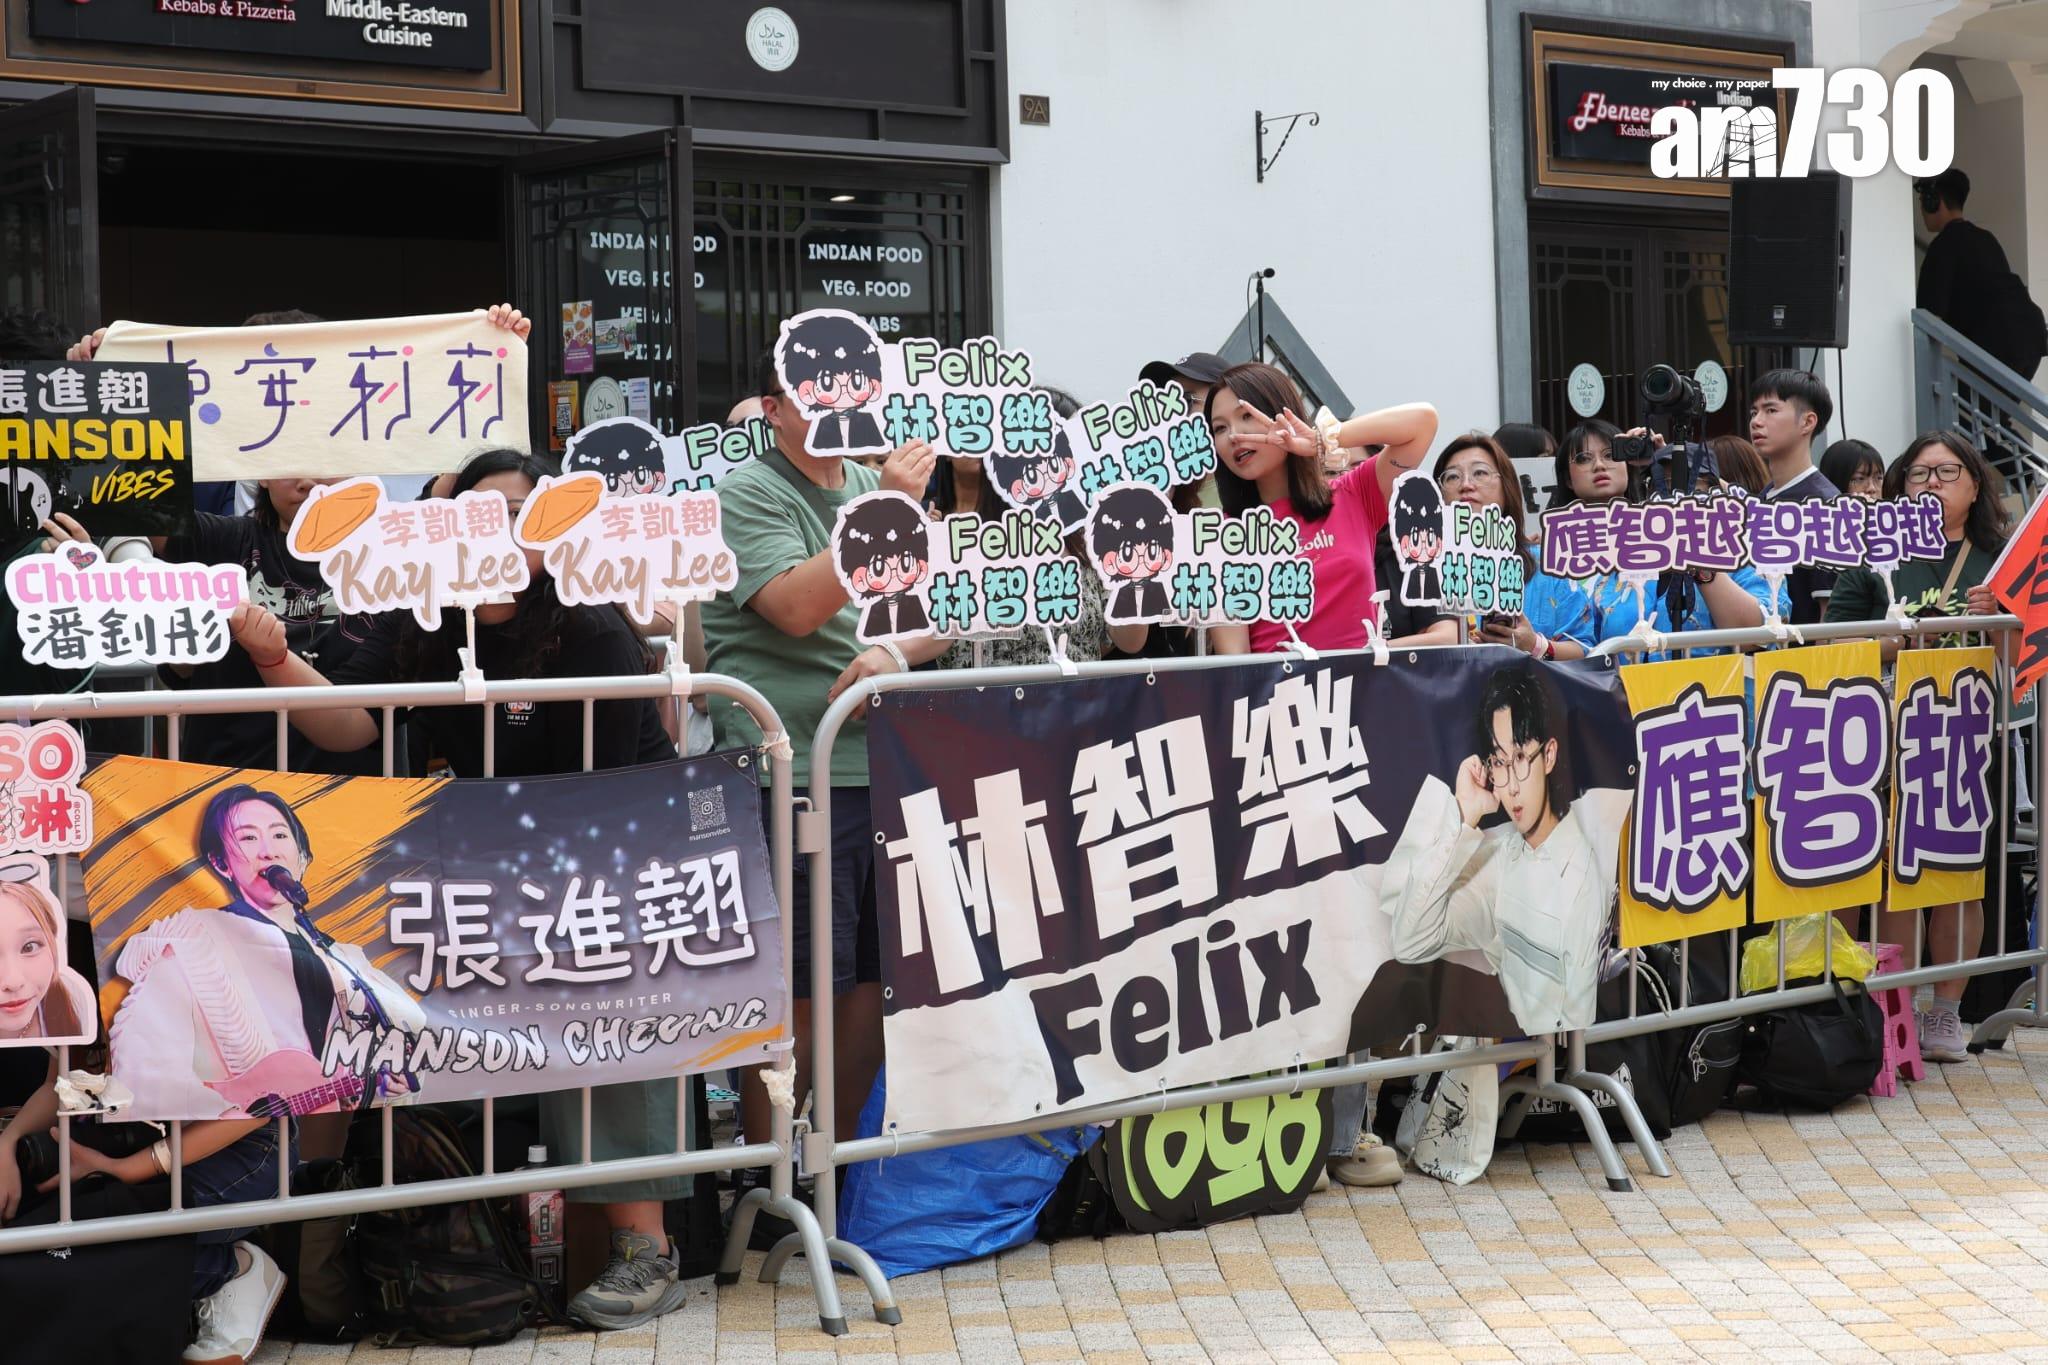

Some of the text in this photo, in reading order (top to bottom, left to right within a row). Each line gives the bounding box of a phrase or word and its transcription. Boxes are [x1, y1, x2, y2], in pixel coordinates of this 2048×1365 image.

[161, 0, 296, 21] Kebabs & Pizzeria
[326, 0, 467, 27] Middle-Eastern
[363, 22, 432, 47] Cuisine
[1024, 97, 1047, 121] 9A
[1620, 123, 1651, 138] Kebabs
[605, 269, 646, 287] VEG.
[808, 243, 923, 263] INDIAN FOOD
[822, 279, 911, 298] VEG. FOOD
[903, 336, 1031, 391] Felix
[0, 419, 184, 460] ANSON
[883, 392, 1053, 456] 林智樂
[1085, 381, 1186, 452] Felix
[1080, 411, 1215, 498] 林智樂
[91, 464, 175, 505] VIBES
[379, 498, 503, 547] 李凱翹
[601, 498, 717, 542] 李凱翹
[948, 514, 1064, 564] Felix
[1193, 510, 1299, 558] Felix
[1454, 503, 1516, 551] Felix
[1545, 499, 1744, 576] 應智越
[1747, 497, 1865, 565] 智越
[15, 562, 240, 610] Chiutung
[327, 542, 522, 623] Kay Lee
[549, 537, 731, 619] Kay Lee
[929, 560, 1081, 631] 林智樂
[1172, 560, 1312, 621] 林智樂
[1441, 552, 1524, 612] 林智樂
[27, 606, 222, 660] 潘釗彤
[885, 667, 1388, 995] 林智樂
[387, 848, 757, 992] 張進翹
[448, 992, 673, 1020] SINGER-SONGWRITER
[1029, 918, 1321, 1106] Felix
[322, 996, 767, 1078] MANSON CHEUNG
